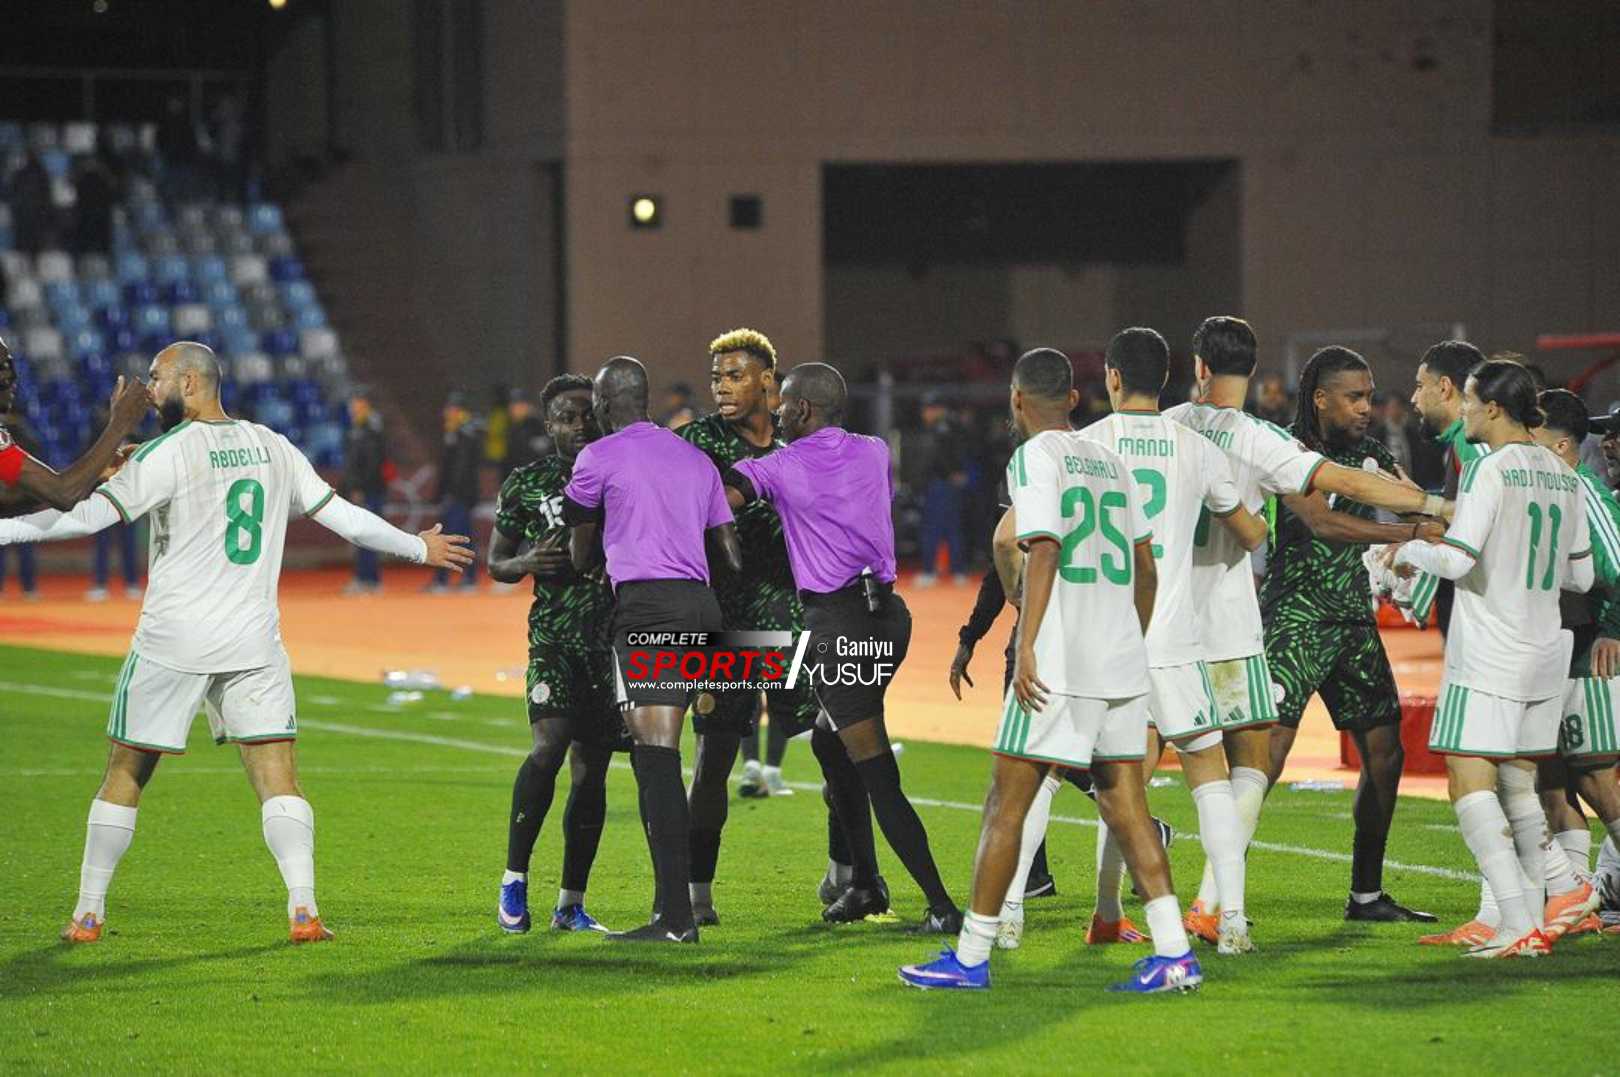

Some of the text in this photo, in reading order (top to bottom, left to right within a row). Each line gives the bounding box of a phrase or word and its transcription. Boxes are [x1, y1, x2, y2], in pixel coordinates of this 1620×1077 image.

[209, 446, 272, 469] ABDELLI
[1118, 437, 1174, 457] MANDI
[1500, 468, 1534, 488] HADJ
[225, 479, 264, 565] 8
[1060, 486, 1131, 586] 25
[1526, 501, 1562, 591] 11
